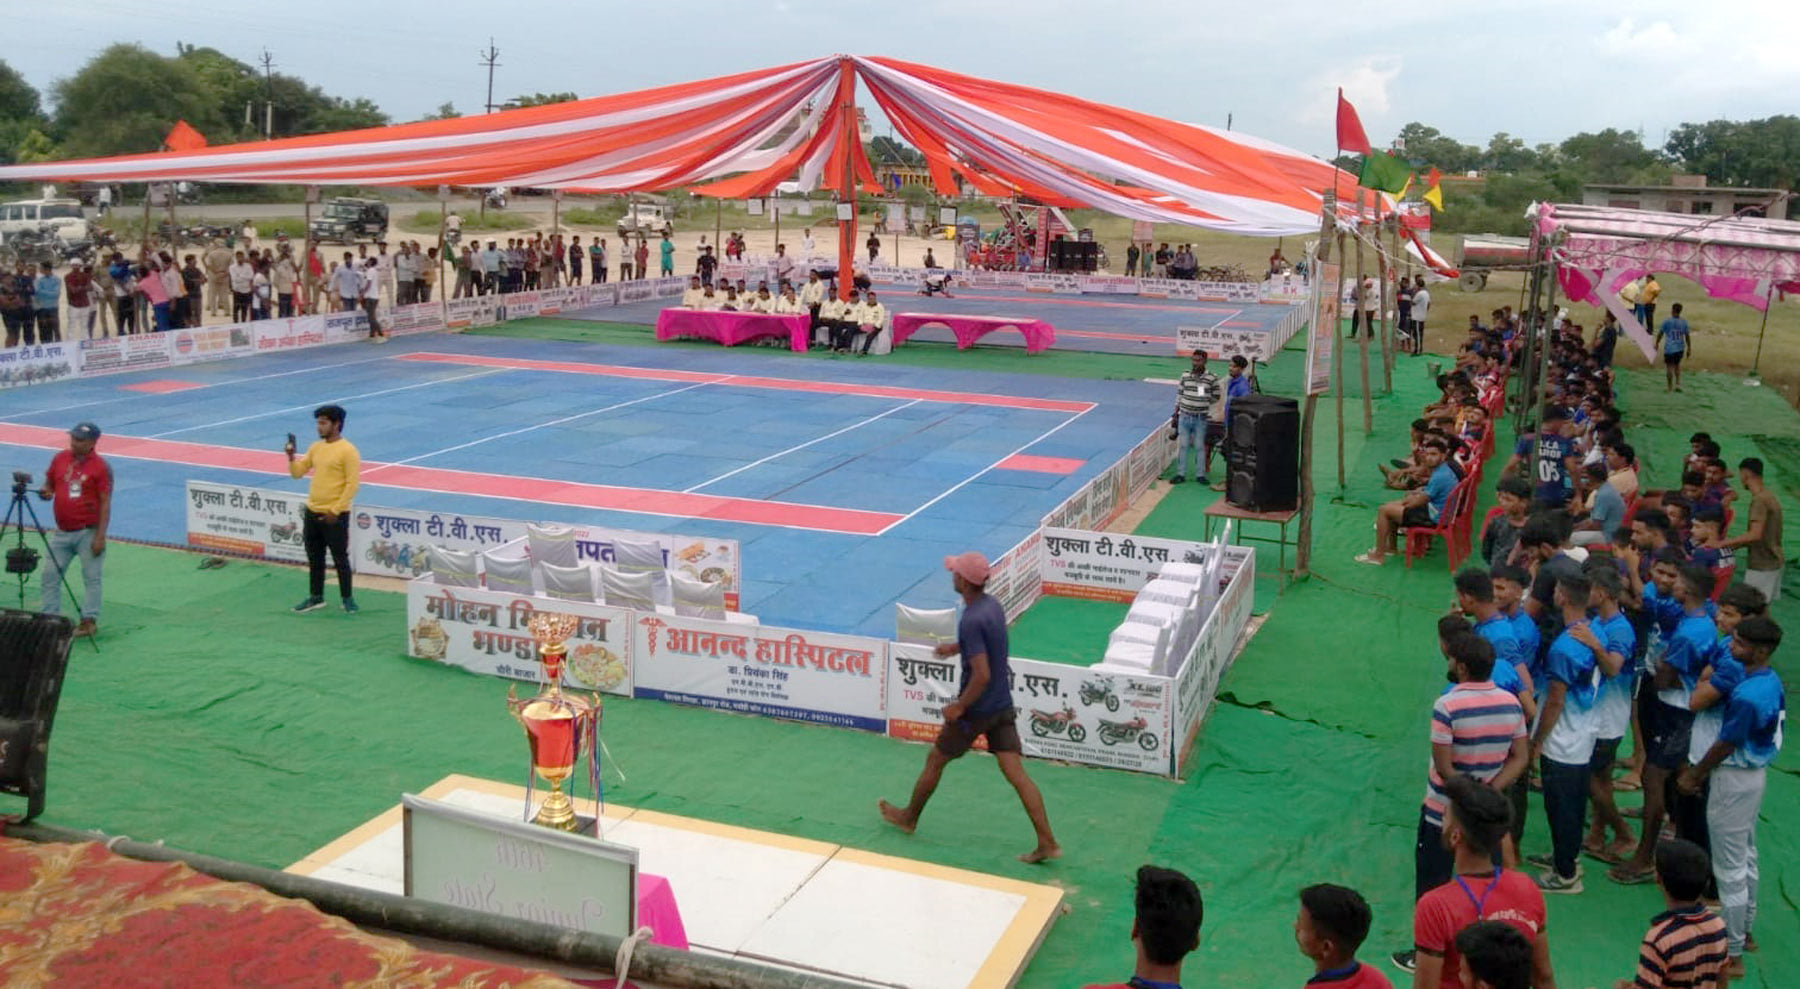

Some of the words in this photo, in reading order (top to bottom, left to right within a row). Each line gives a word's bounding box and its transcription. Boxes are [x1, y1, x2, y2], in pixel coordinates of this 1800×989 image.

[1539, 459, 1561, 482] 05
[190, 488, 226, 509] शुक्ला
[375, 514, 420, 538] शुक्ला
[426, 515, 509, 545] टी.वी.एस.
[1044, 534, 1090, 557] शुक्ला
[1094, 535, 1176, 564] टी.वी.एस.
[425, 588, 502, 628] मोहन
[665, 627, 750, 662] आनन्द
[753, 633, 876, 677] हास्पिटल
[895, 656, 956, 686] शुक्ला
[904, 689, 924, 701] TVS
